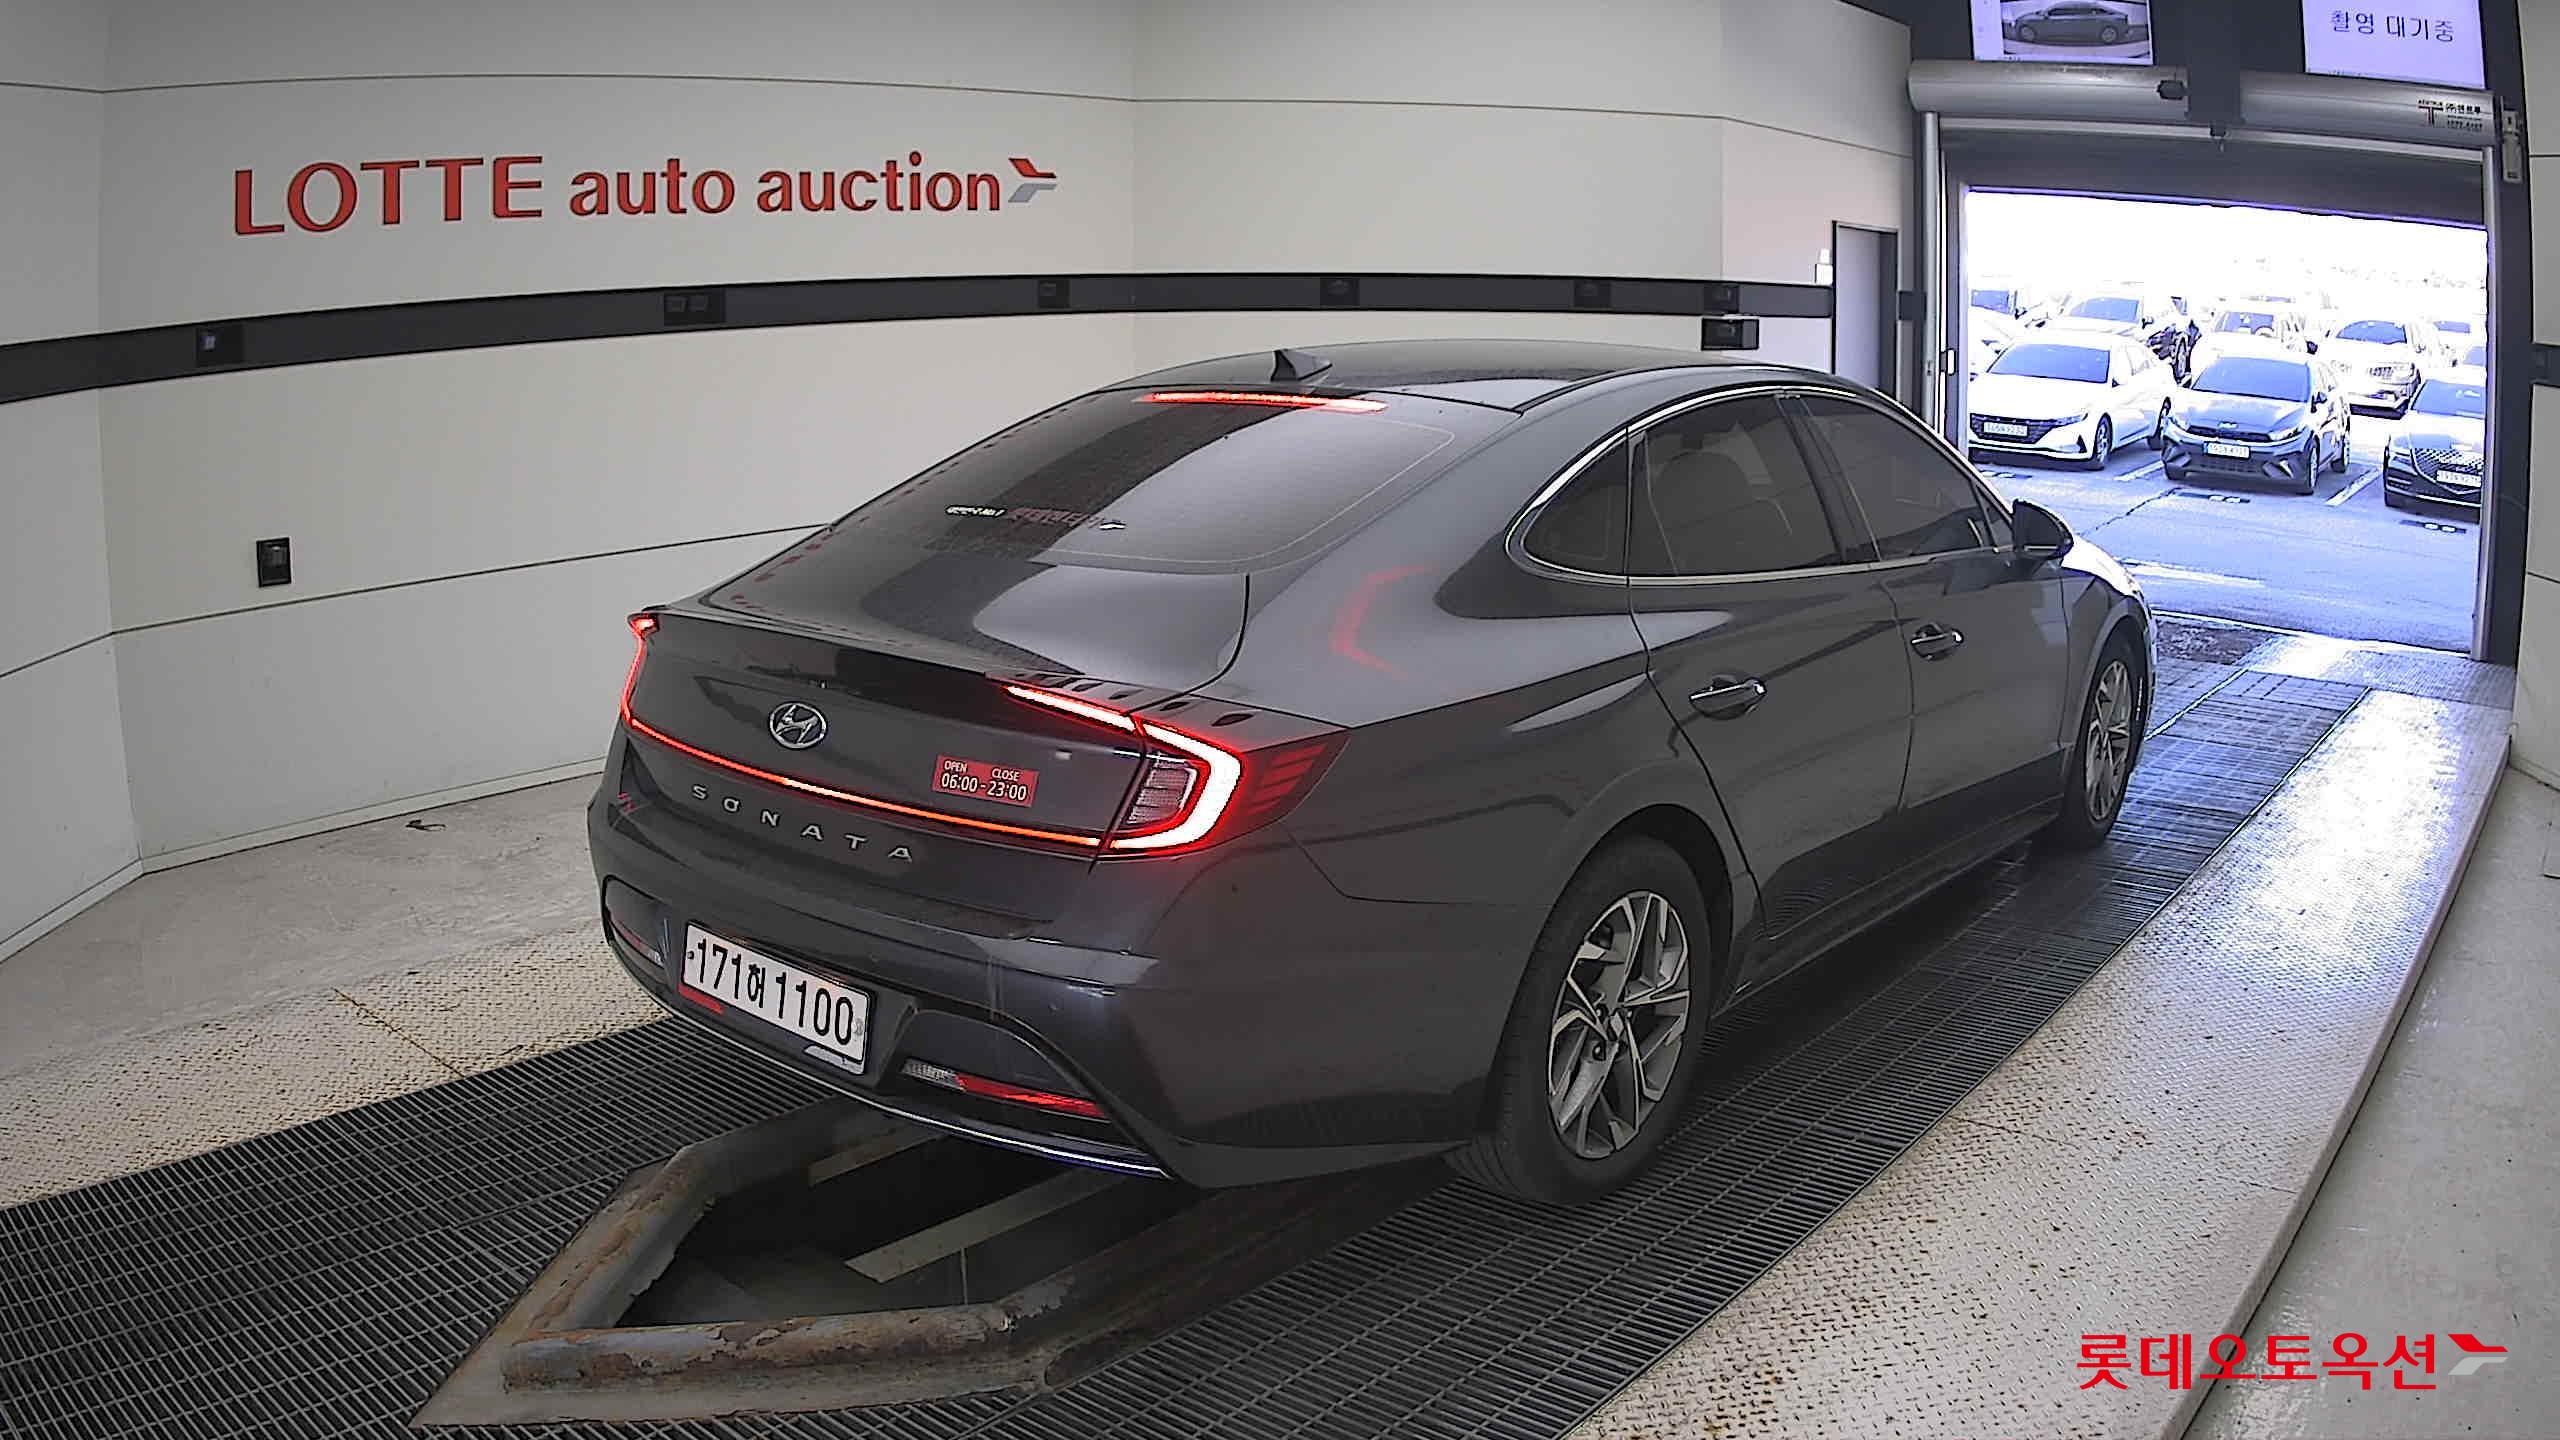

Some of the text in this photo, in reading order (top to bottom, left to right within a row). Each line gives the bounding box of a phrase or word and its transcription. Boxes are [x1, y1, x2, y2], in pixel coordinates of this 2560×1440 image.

[2331, 10, 2454, 42] 촬영 대기중
[234, 152, 1002, 237] LOTTE auto auction
[944, 760, 1021, 781] OPEN CLOSE
[692, 784, 913, 863] SONATA
